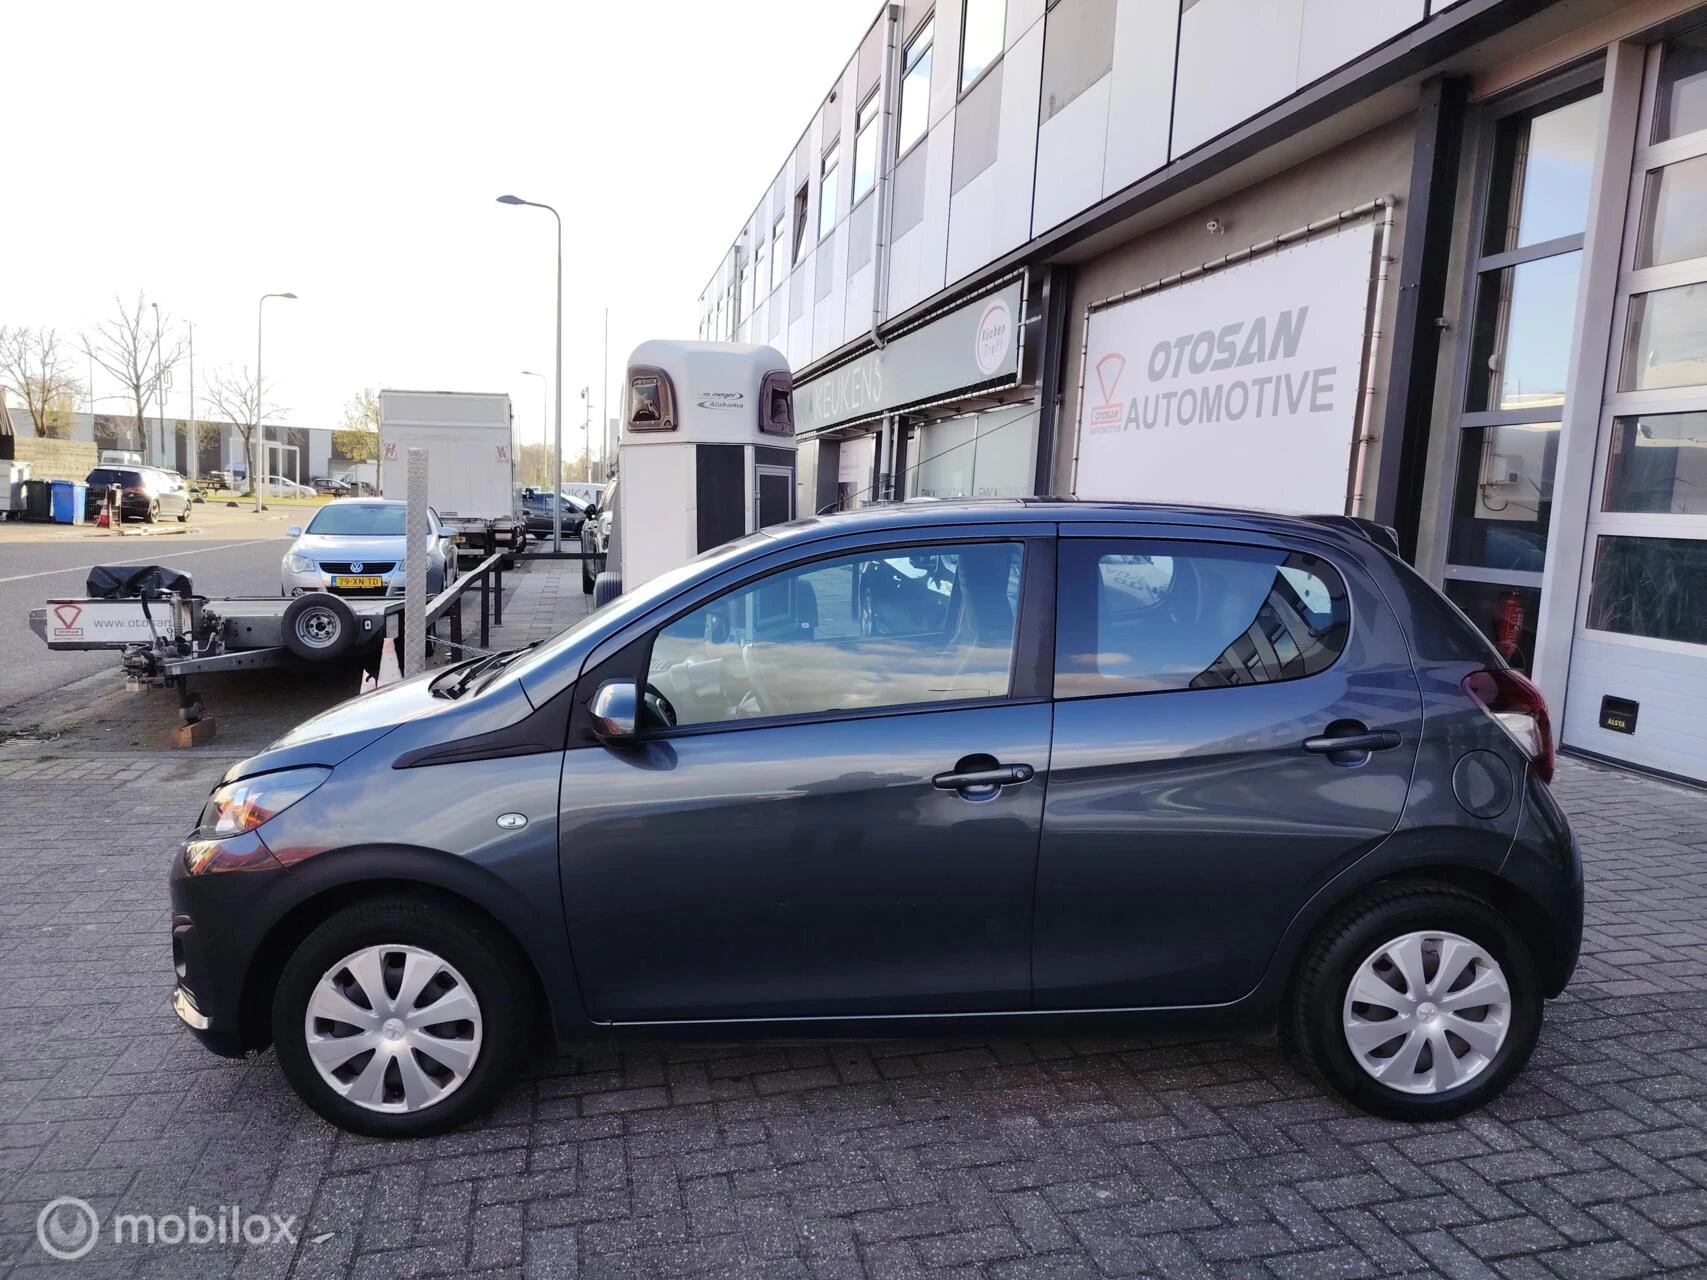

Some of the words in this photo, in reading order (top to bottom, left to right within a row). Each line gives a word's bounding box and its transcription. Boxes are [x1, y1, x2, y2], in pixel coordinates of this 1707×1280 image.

[1147, 305, 1310, 382] OTOSAN
[814, 356, 882, 424] KEUKENS
[1123, 366, 1337, 432] AUTOMOTIVE
[1607, 717, 1626, 728] ALSTA
